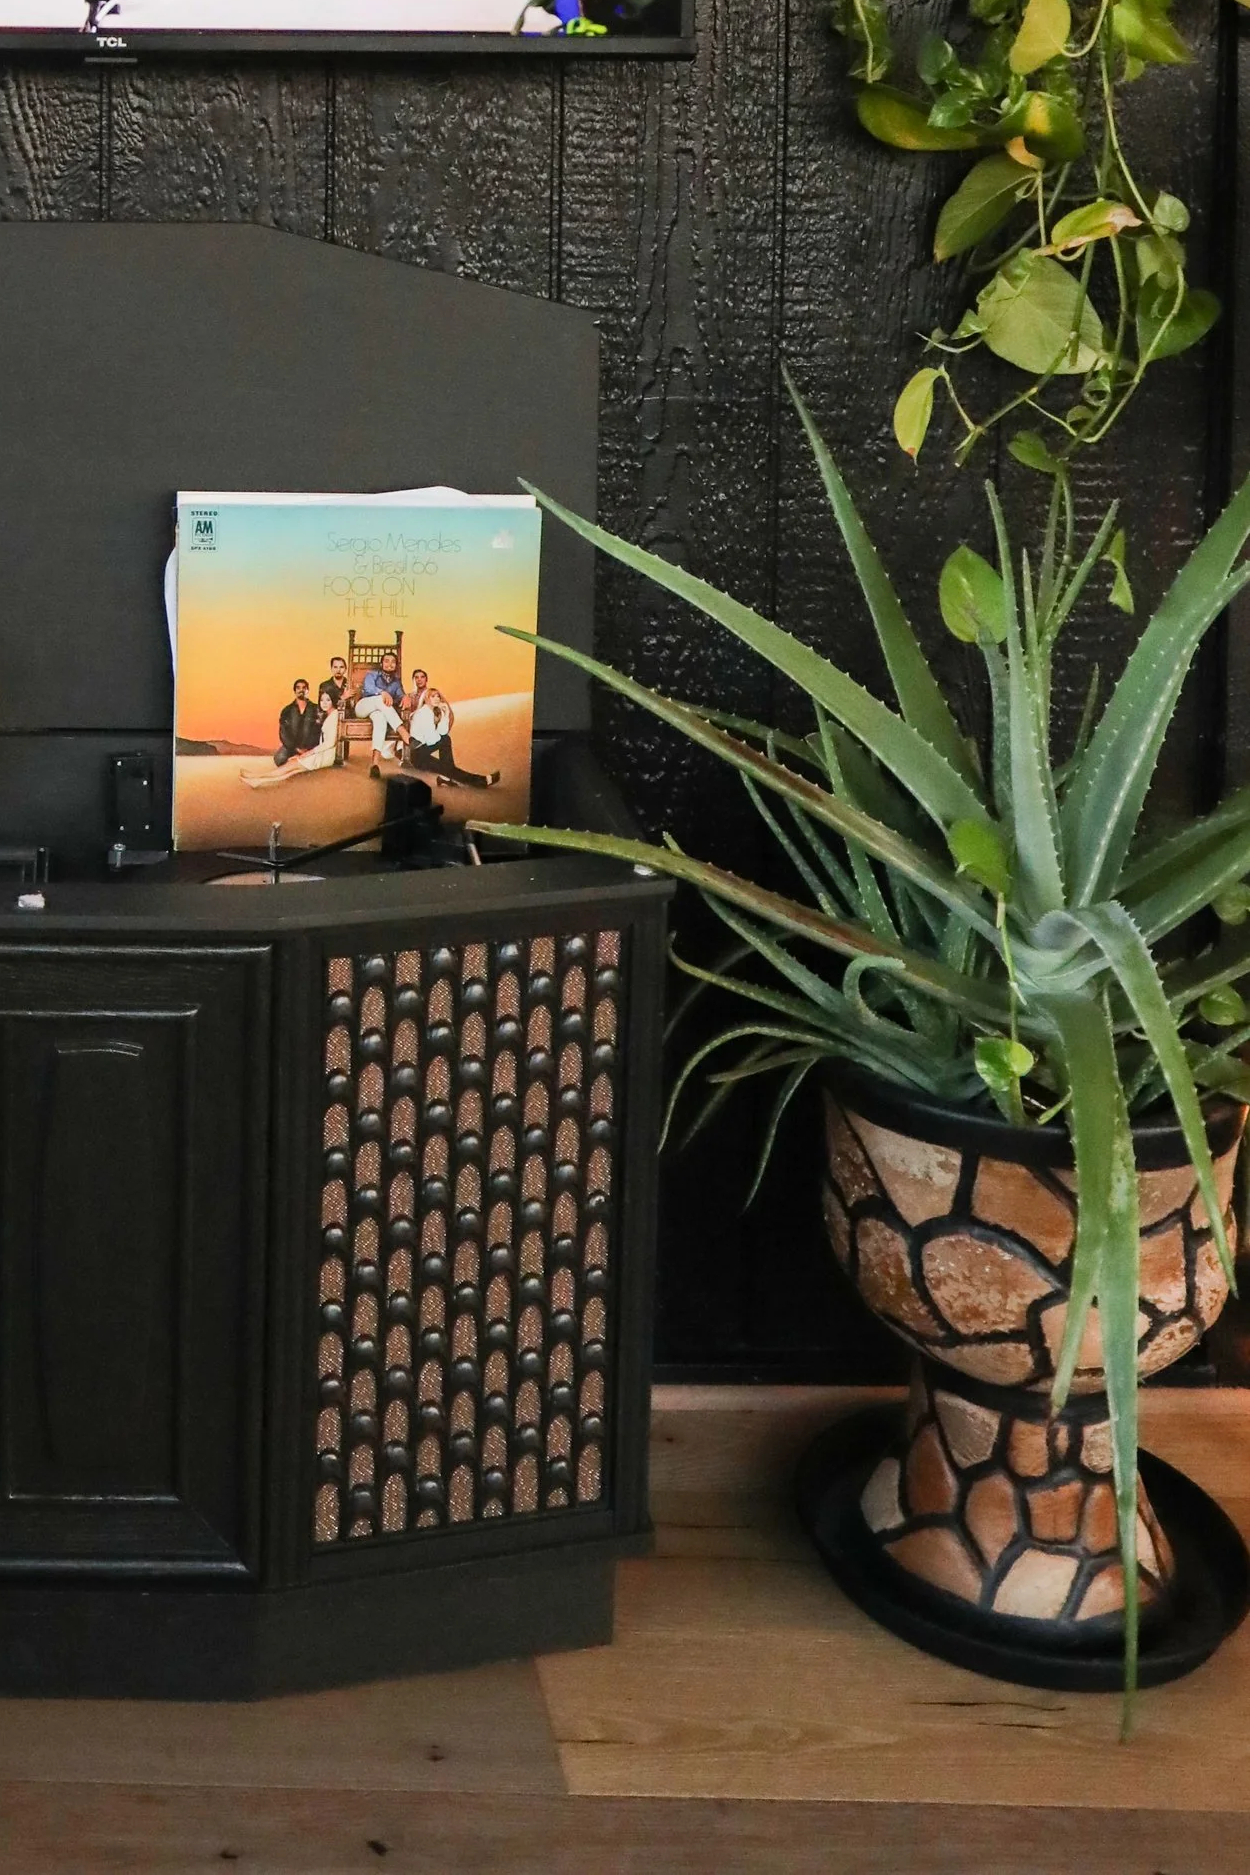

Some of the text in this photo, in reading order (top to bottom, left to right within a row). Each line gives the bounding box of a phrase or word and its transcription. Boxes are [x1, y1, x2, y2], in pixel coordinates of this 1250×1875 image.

[96, 35, 127, 48] TCL
[326, 530, 461, 557] Sergio Mendes
[353, 555, 368, 574] &
[372, 554, 408, 575] Brasil
[323, 576, 415, 596] FOOL ON
[344, 597, 409, 618] THE HILL
